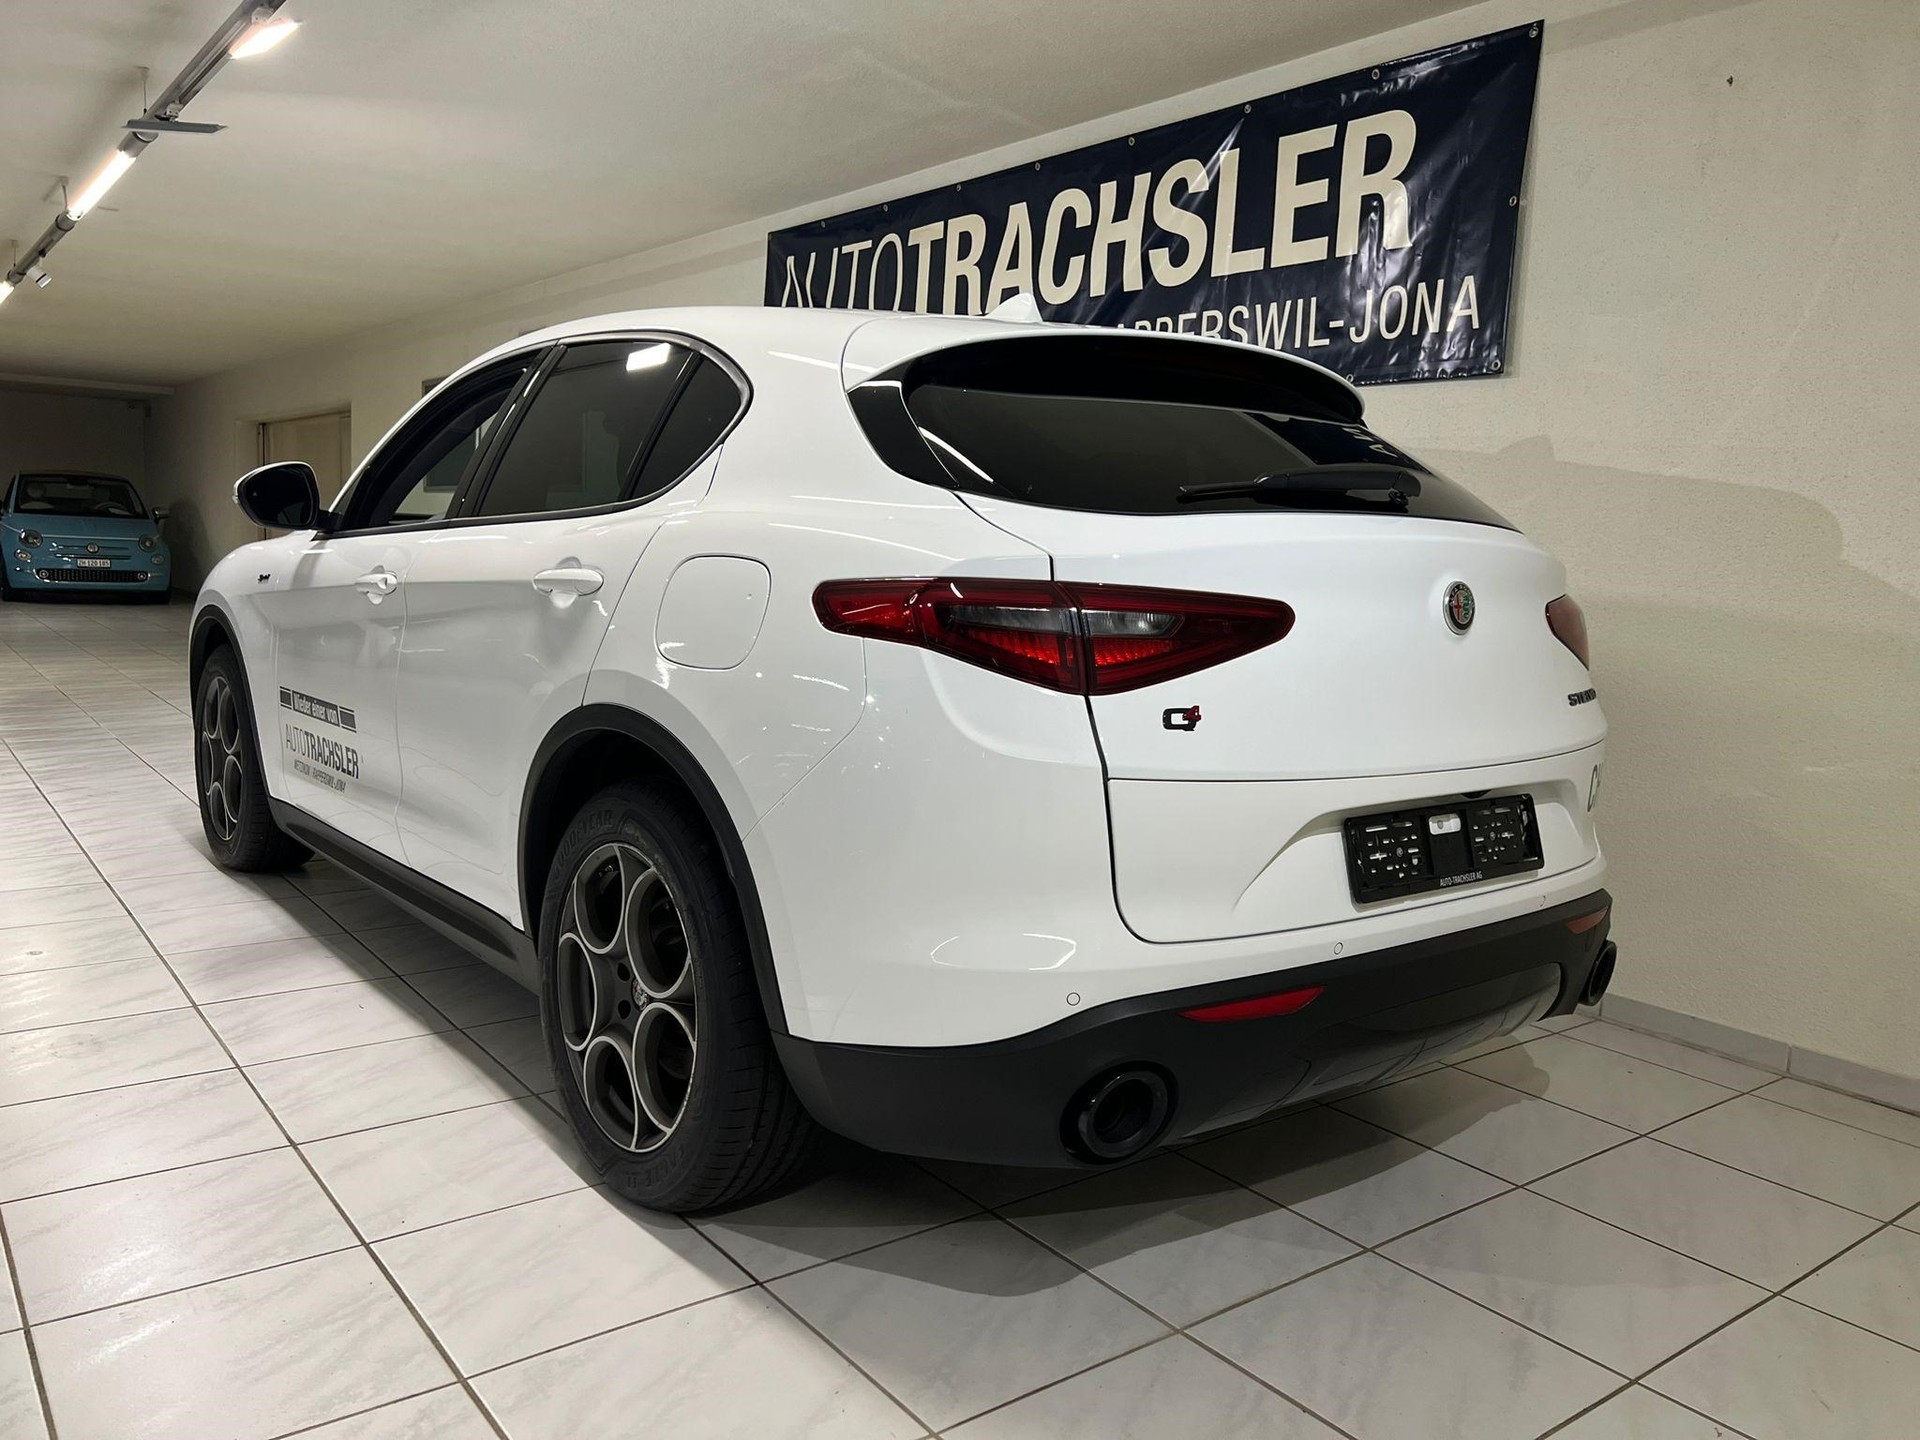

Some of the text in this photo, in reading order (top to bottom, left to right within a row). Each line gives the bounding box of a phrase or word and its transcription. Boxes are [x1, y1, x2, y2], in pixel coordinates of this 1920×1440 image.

[781, 109, 1417, 316] AUTOTRACHSLER
[1117, 275, 1481, 351] ERSWIL-JONA
[285, 723, 359, 779] AUTOTRACHSLER
